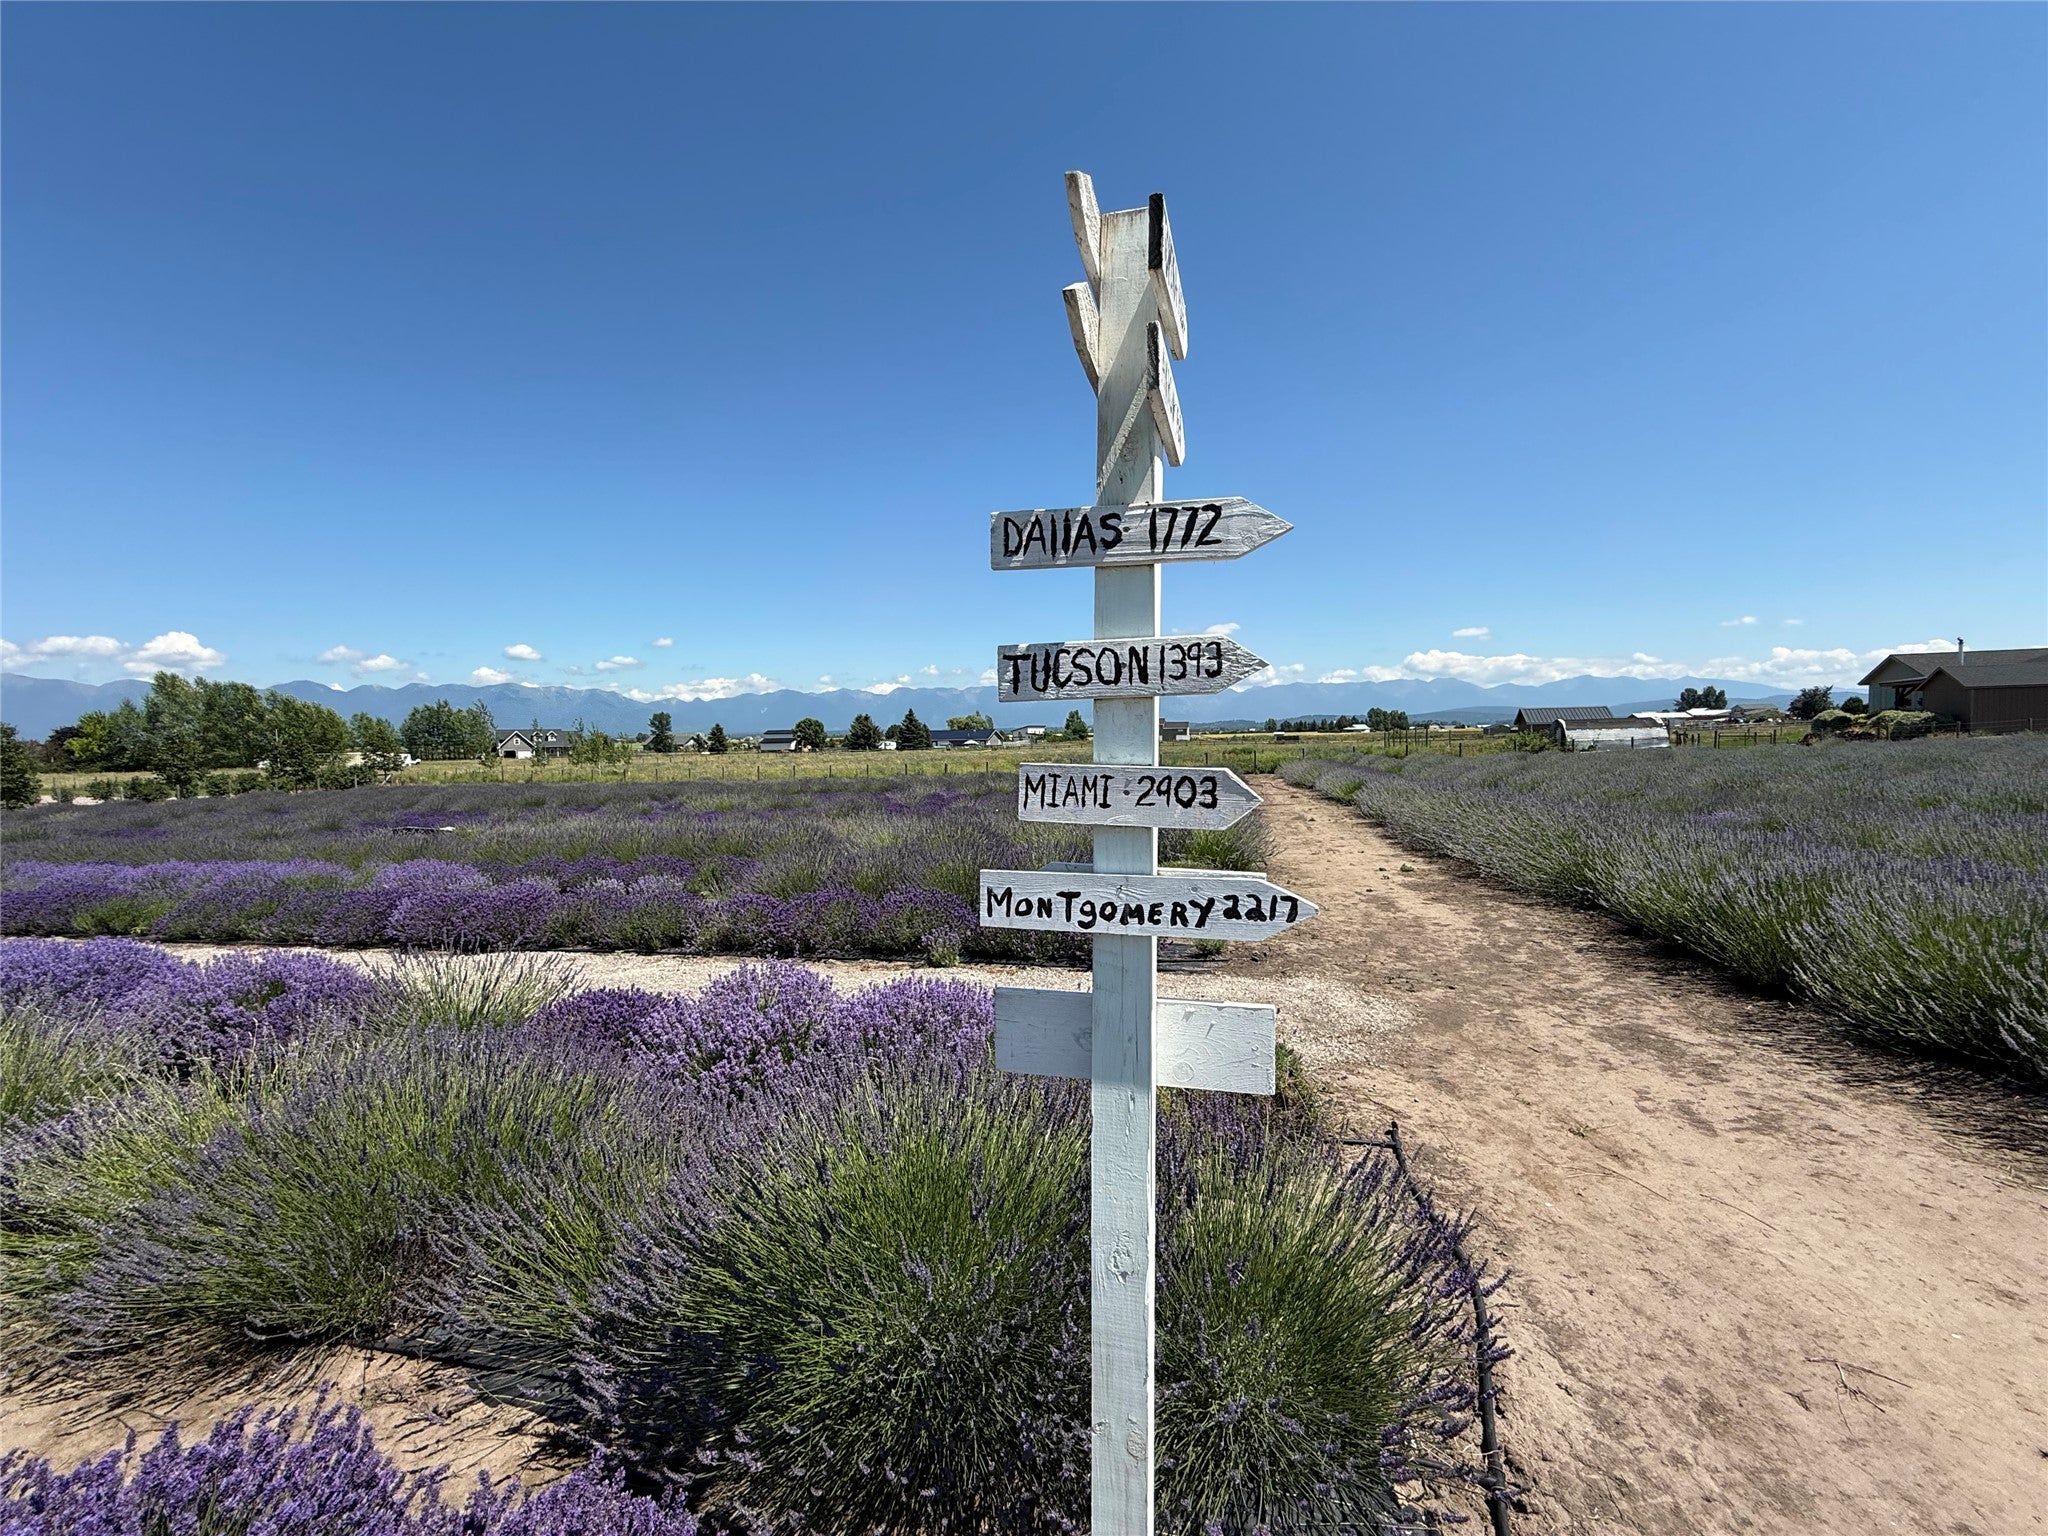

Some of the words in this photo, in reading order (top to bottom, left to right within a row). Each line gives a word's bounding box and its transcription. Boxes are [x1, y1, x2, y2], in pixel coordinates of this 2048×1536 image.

[1150, 504, 1222, 553] 1772
[1003, 645, 1149, 695] TUCSON
[1160, 641, 1223, 690] 1393
[1023, 773, 1114, 810] MIAMI
[1135, 775, 1219, 809] 2903
[1222, 894, 1299, 923] 2217
